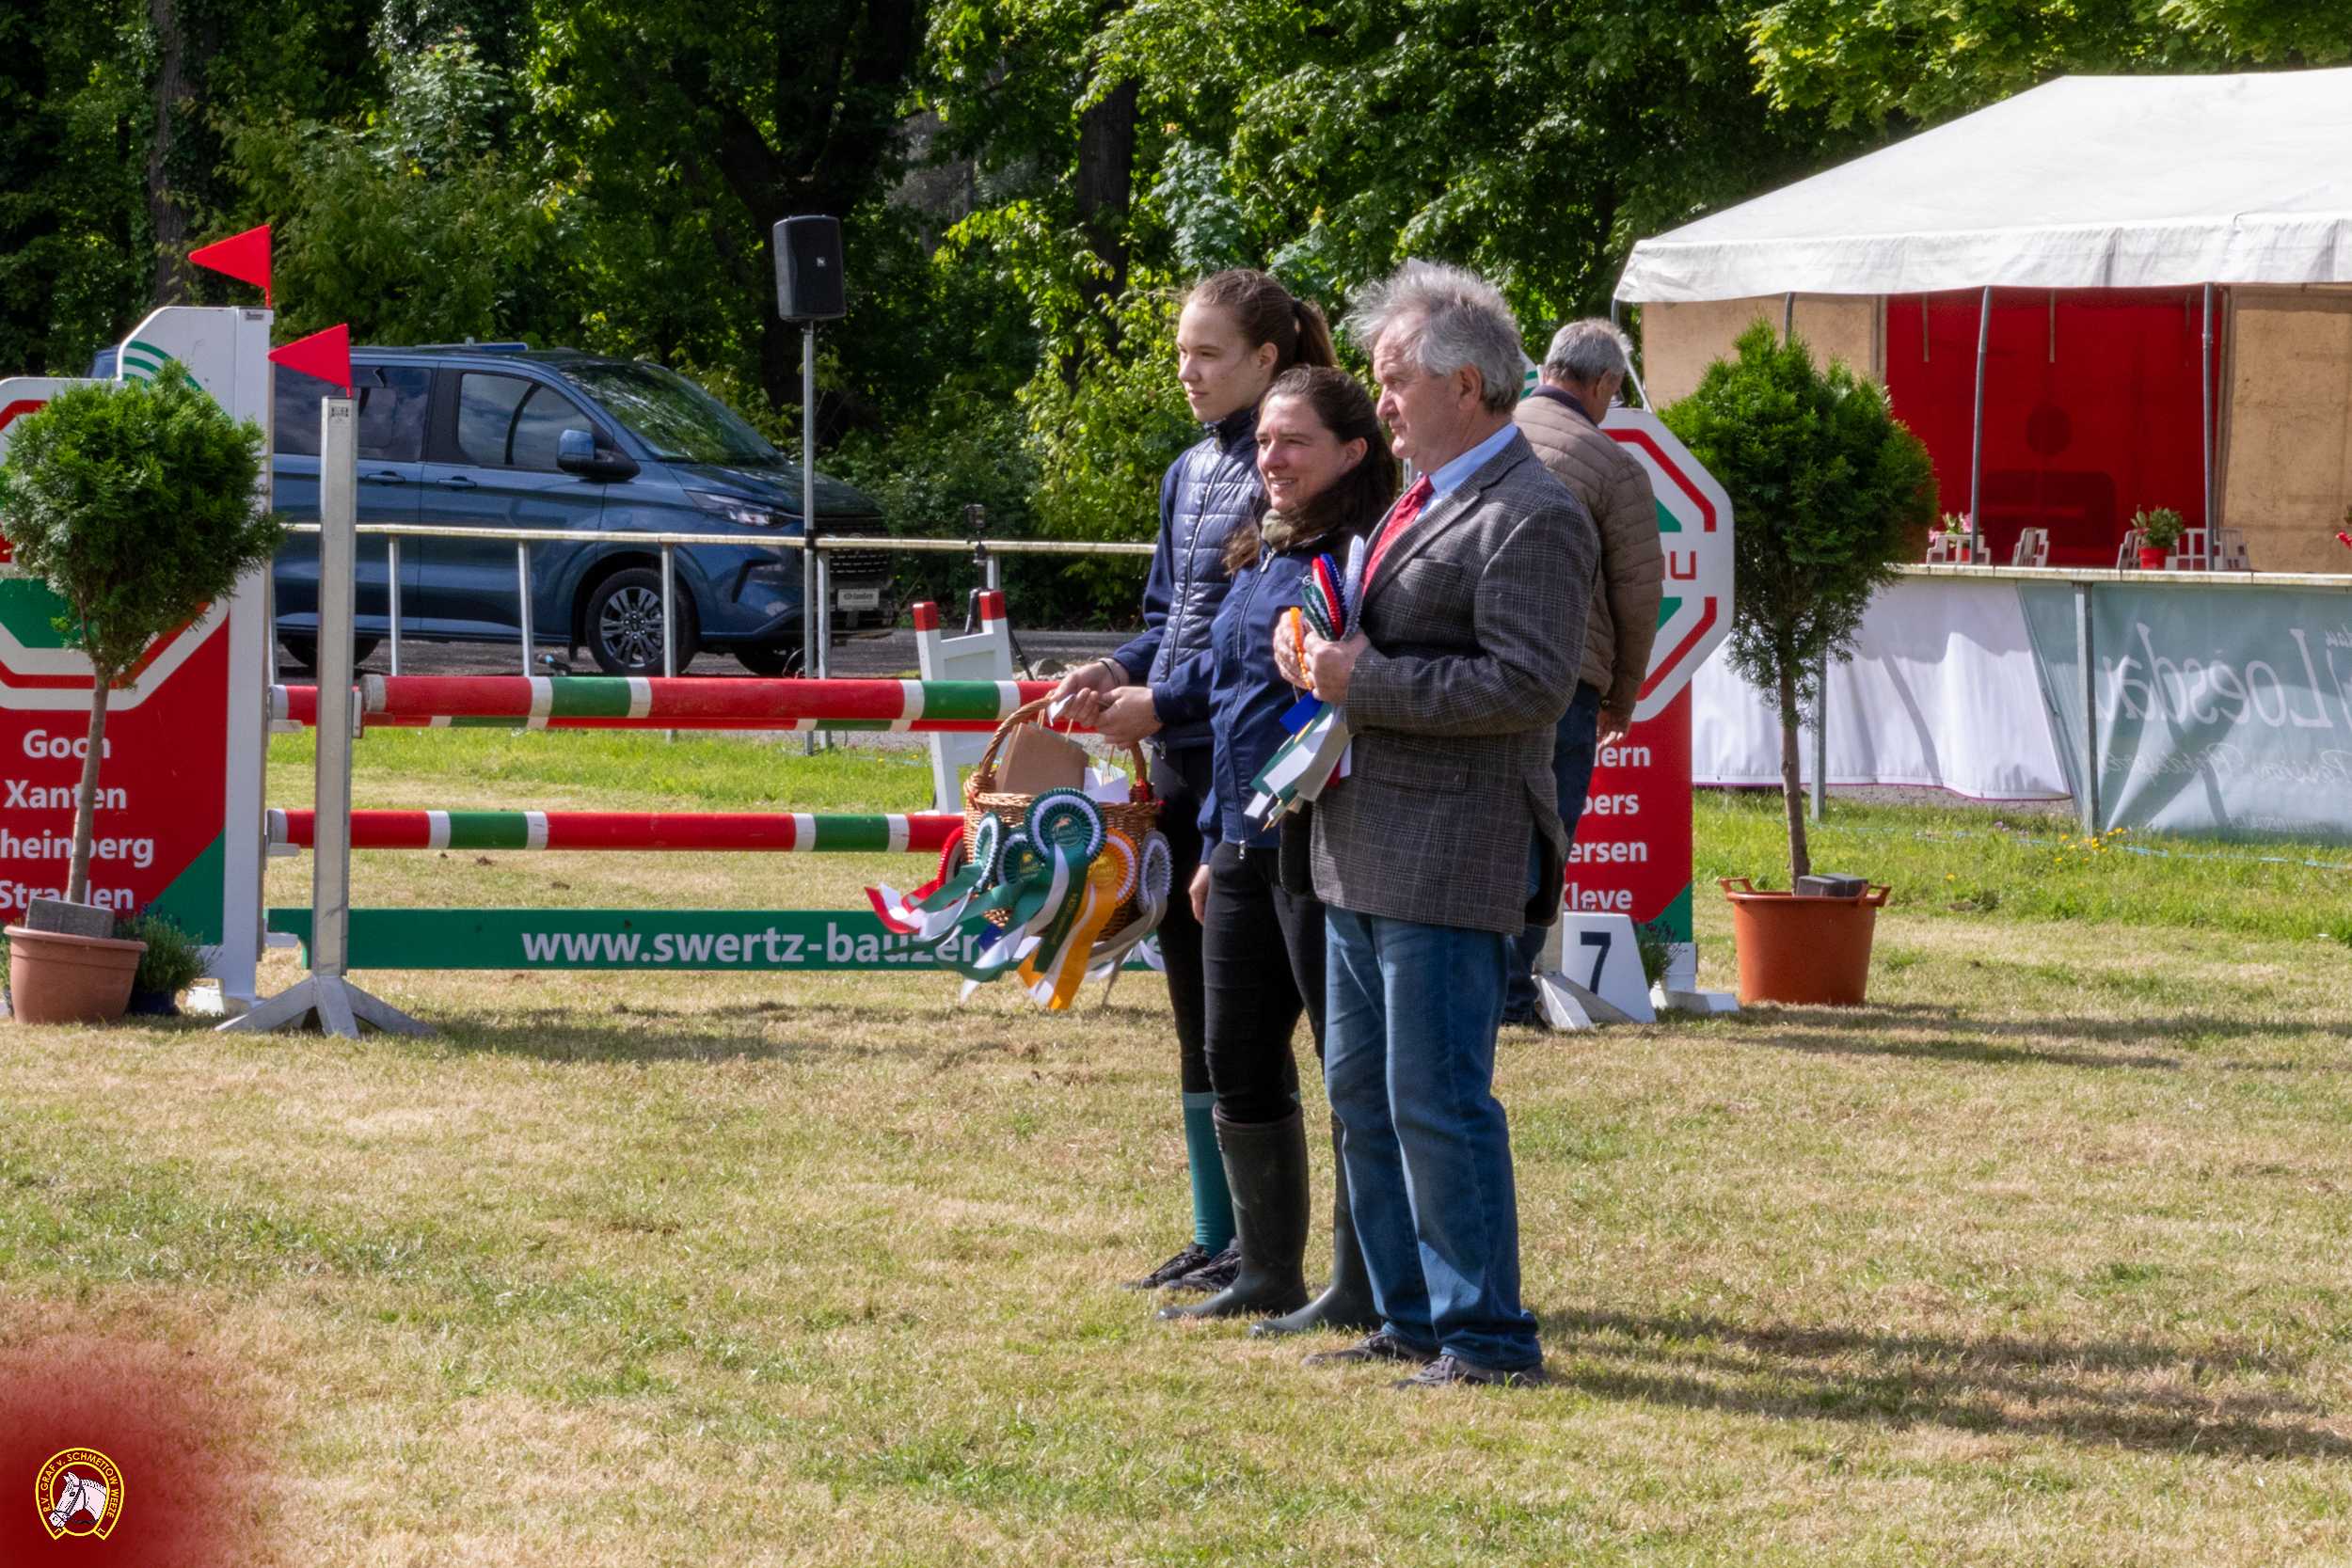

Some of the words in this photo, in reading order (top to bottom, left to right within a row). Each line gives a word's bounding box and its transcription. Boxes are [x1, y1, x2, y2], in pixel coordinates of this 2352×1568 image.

[1661, 550, 1696, 580] U
[4, 779, 127, 810] Xanten
[0, 880, 134, 909] Stralen
[521, 922, 985, 962] www.swertz-bauzen
[1581, 931, 1612, 995] 7
